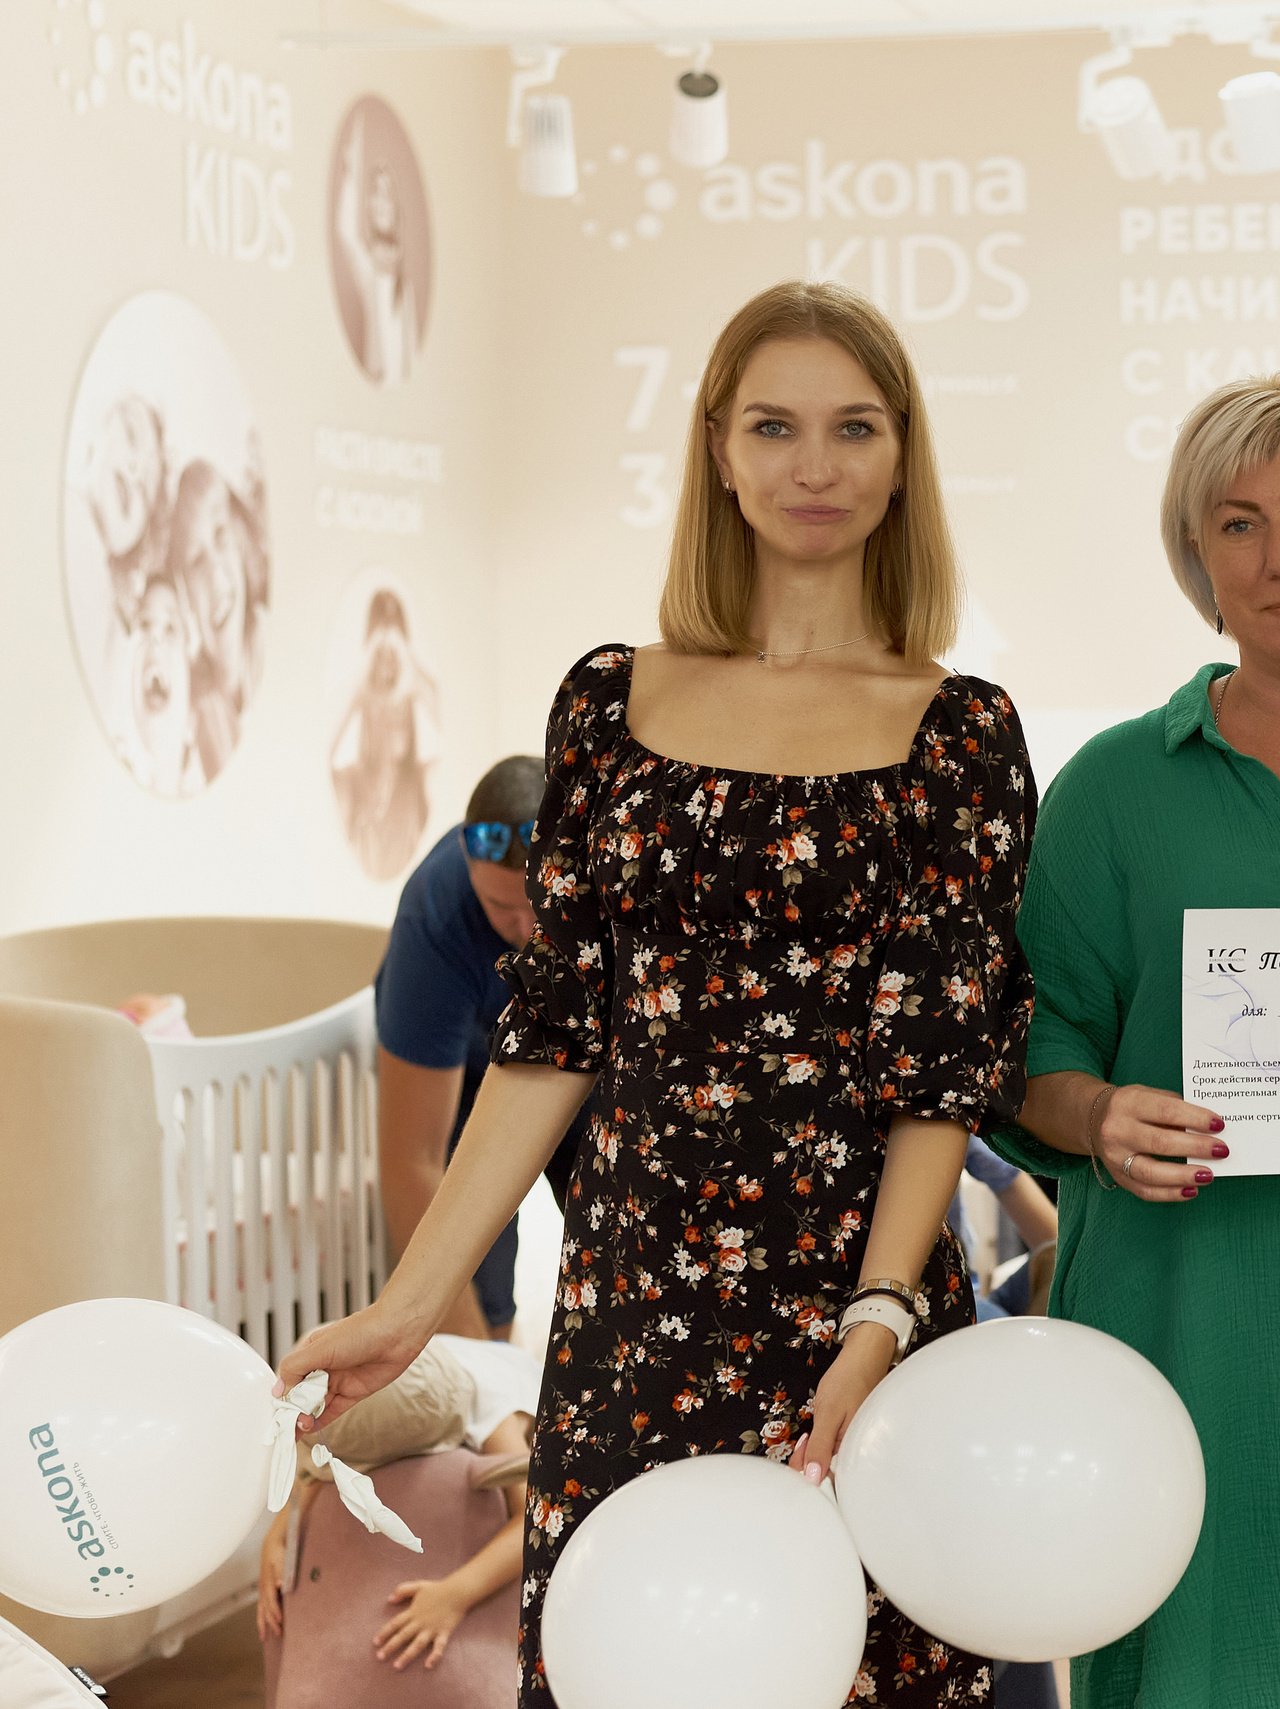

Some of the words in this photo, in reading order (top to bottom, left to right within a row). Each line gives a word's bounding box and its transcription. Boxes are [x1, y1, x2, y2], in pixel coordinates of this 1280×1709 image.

[126, 20, 293, 150] askona
[702, 139, 1028, 222] askona
[185, 141, 296, 271] KIDS
[806, 231, 1030, 324] KIDS
[1119, 347, 1164, 396] С
[1241, 1002, 1268, 1017] для:
[1192, 1059, 1261, 1070] Длительность
[1192, 1075, 1216, 1086] Срок
[1218, 1074, 1262, 1085] действия
[1192, 1089, 1277, 1100] Предварительная
[28, 1422, 105, 1561] askona
[72, 1461, 88, 1488] ЖИТЬ
[84, 1490, 102, 1521] ЧТОБЫ
